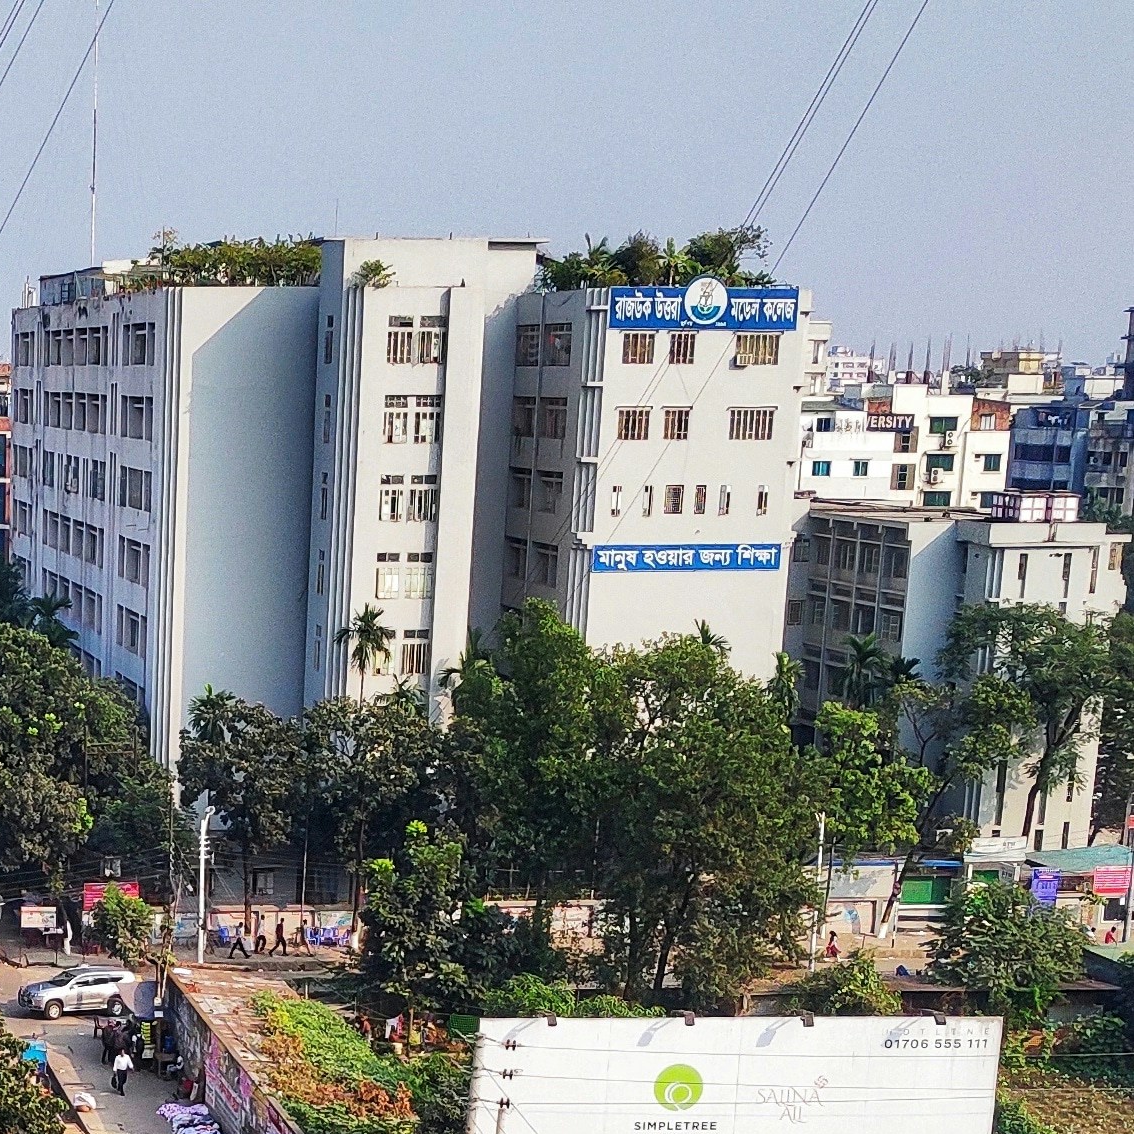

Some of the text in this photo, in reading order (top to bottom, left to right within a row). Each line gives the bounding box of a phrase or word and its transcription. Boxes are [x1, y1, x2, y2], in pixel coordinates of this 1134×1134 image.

[615, 289, 797, 322] রাজউক উত্তরা মডেল কলেজ
[597, 544, 777, 571] মানুষ হওয়ার জন্য শিক্ষা
[884, 1039, 988, 1049] 01706 555 111
[634, 1121, 718, 1131] SIMPLETREE
